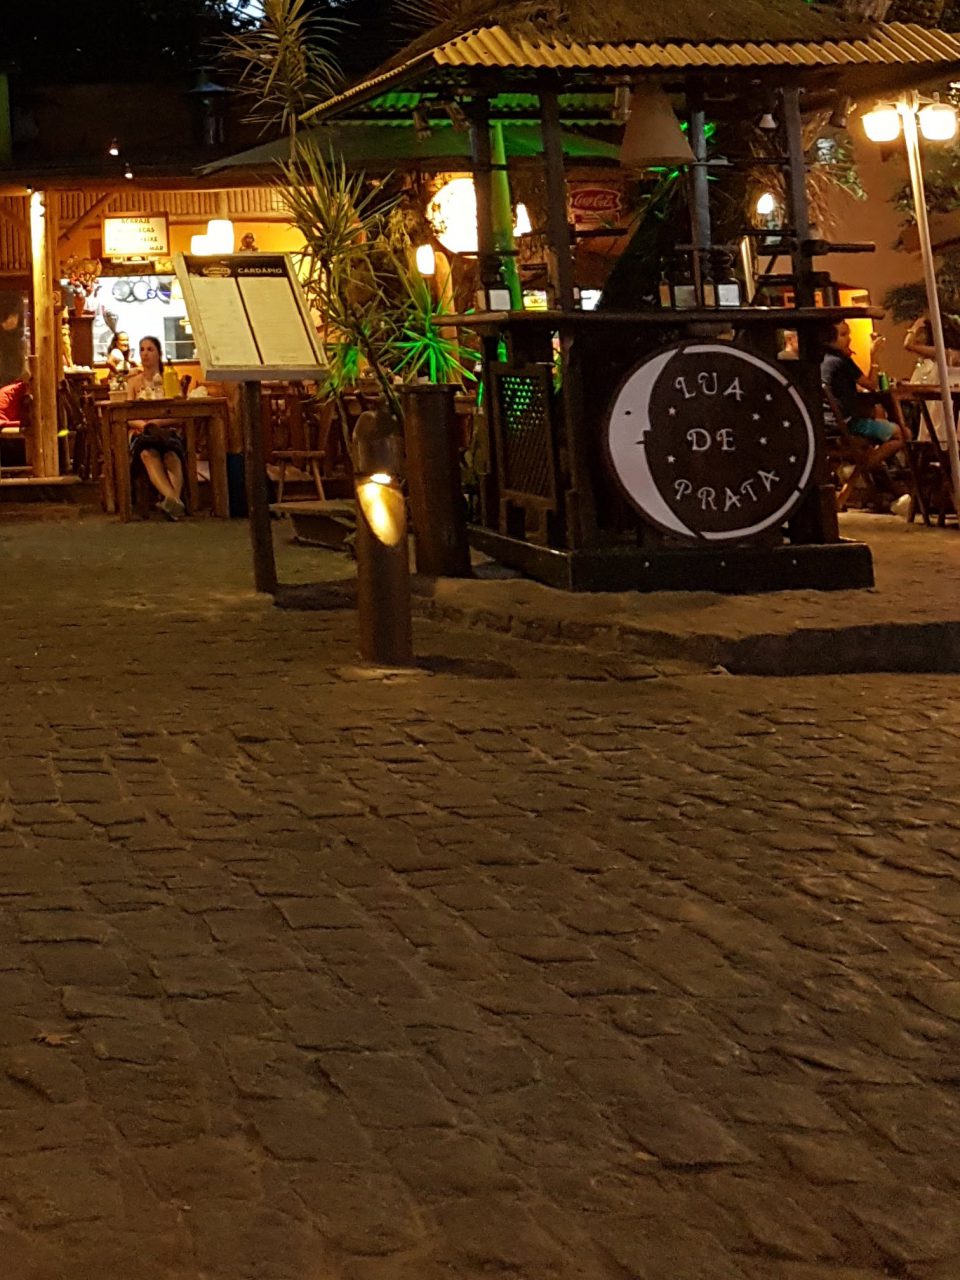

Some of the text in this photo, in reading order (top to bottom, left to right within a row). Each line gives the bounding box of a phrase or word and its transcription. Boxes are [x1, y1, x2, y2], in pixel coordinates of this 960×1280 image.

[674, 371, 744, 401] LUA
[686, 427, 736, 451] DE
[674, 469, 781, 513] PRATA
